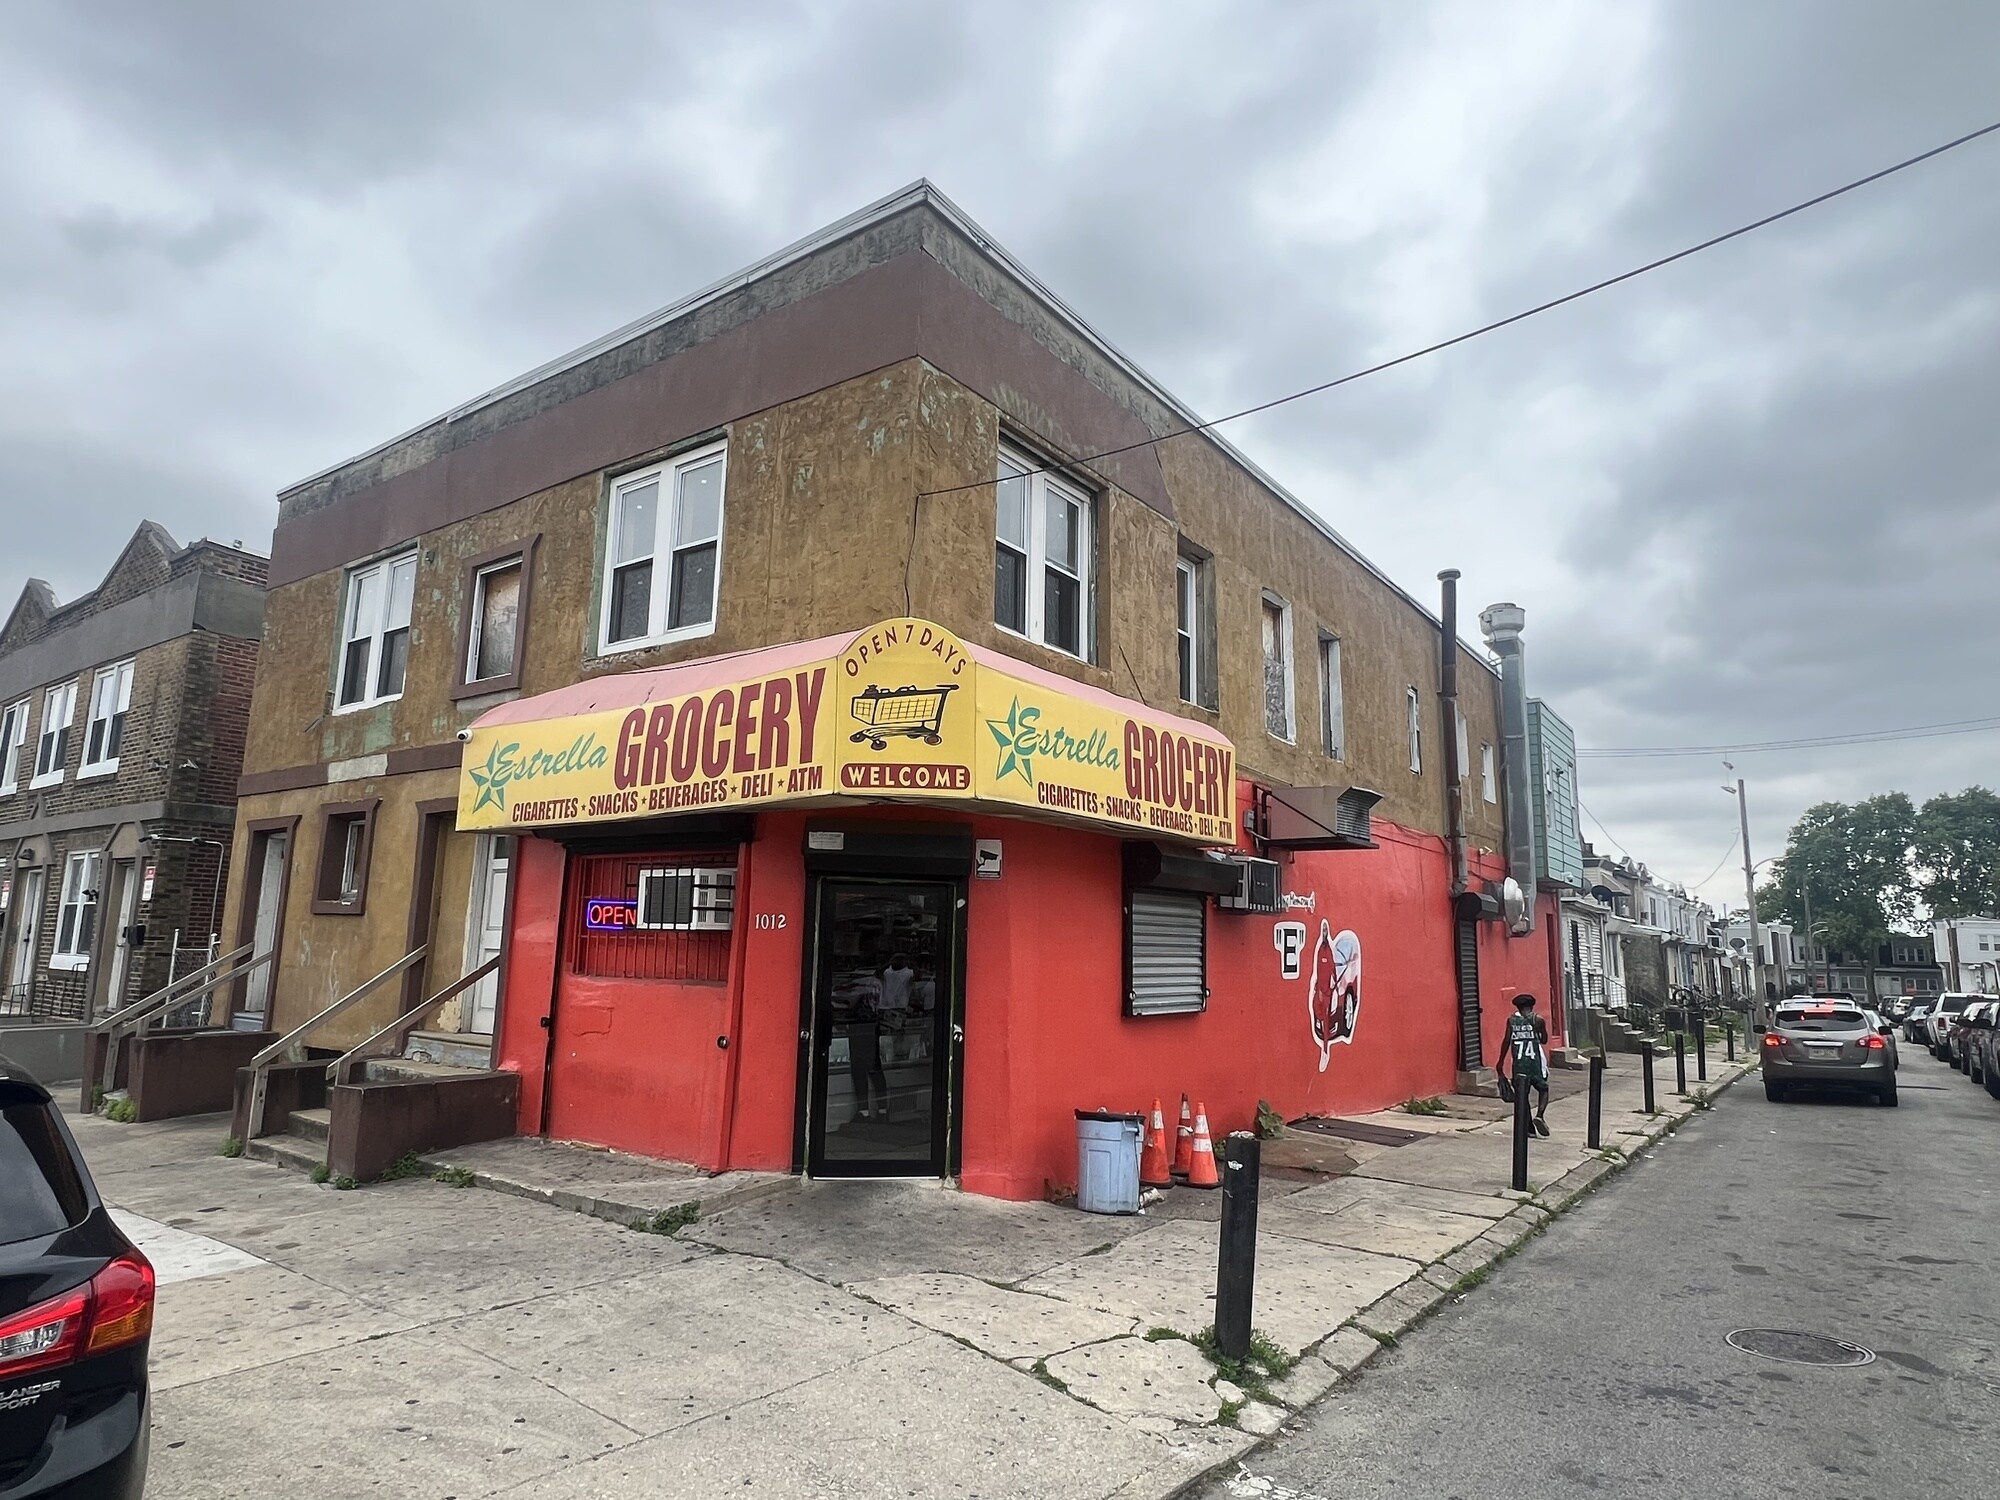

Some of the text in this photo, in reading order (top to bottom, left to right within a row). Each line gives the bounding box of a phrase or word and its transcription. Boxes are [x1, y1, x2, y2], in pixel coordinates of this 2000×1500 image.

[845, 624, 967, 677] OPEN 7 DAYS
[491, 667, 827, 790] Estrella GROCERY
[1014, 706, 1232, 819] Estrella GROCERY
[847, 765, 967, 789] WELCOME
[511, 765, 823, 823] CIGARETTES SNACKS BEVERAGES DELI ATM
[1037, 781, 1232, 839] CIGARETTES SNACKS BEVERAGES DELI ATM
[589, 904, 637, 925] OPEN
[754, 912, 787, 930] 1012
[1514, 1040, 1535, 1060] 74
[0, 1380, 61, 1401] LANDER
[0, 1394, 40, 1410] PORT
